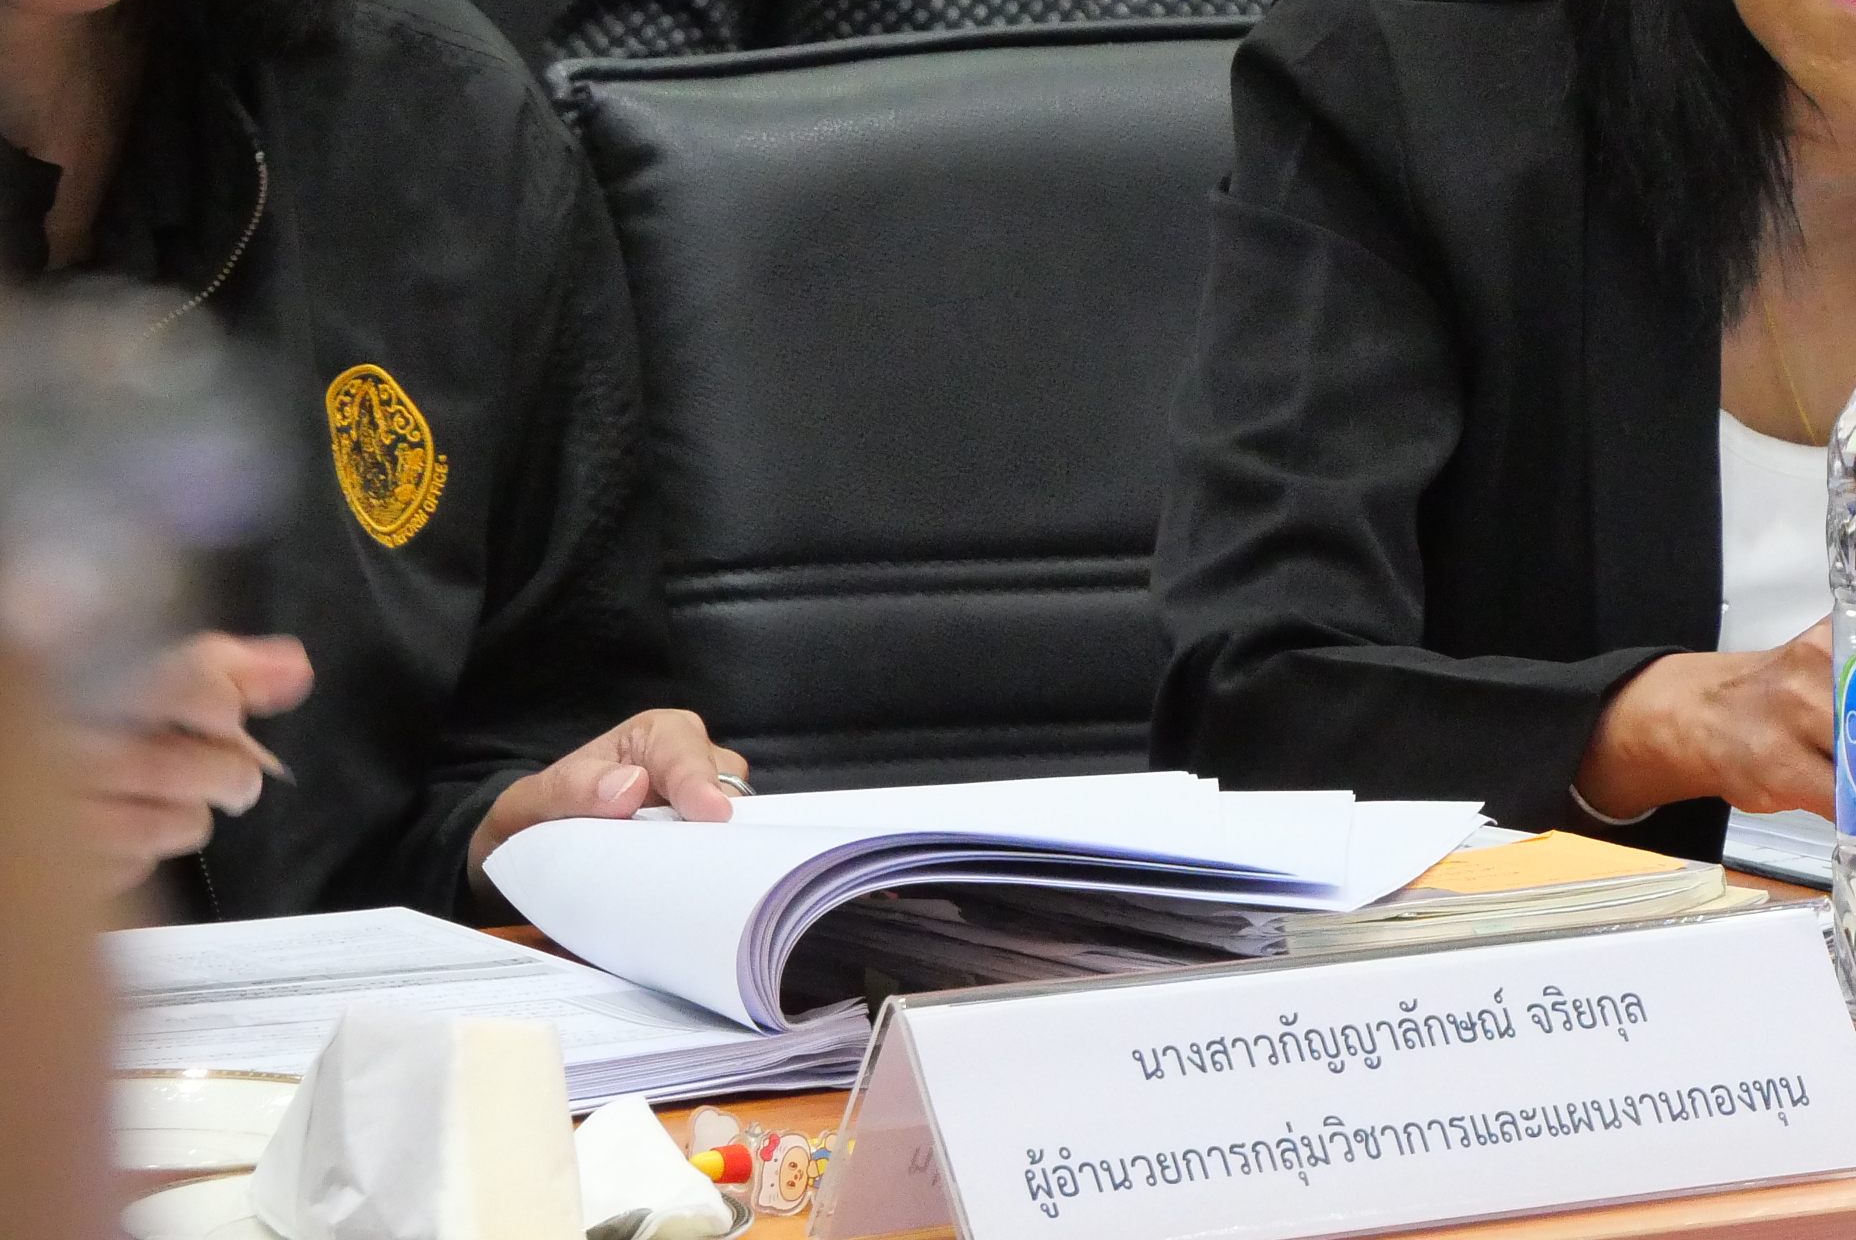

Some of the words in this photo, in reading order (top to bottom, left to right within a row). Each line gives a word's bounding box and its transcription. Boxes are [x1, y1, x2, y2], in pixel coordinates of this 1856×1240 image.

[1131, 987, 1516, 1081] นางสาวกัญญาลักษณ์
[1526, 985, 1649, 1043] จริยกุล
[1024, 1074, 1811, 1219] ผู้อำนวยการกลุ่มวิชาการและแผนงานกองทุน
